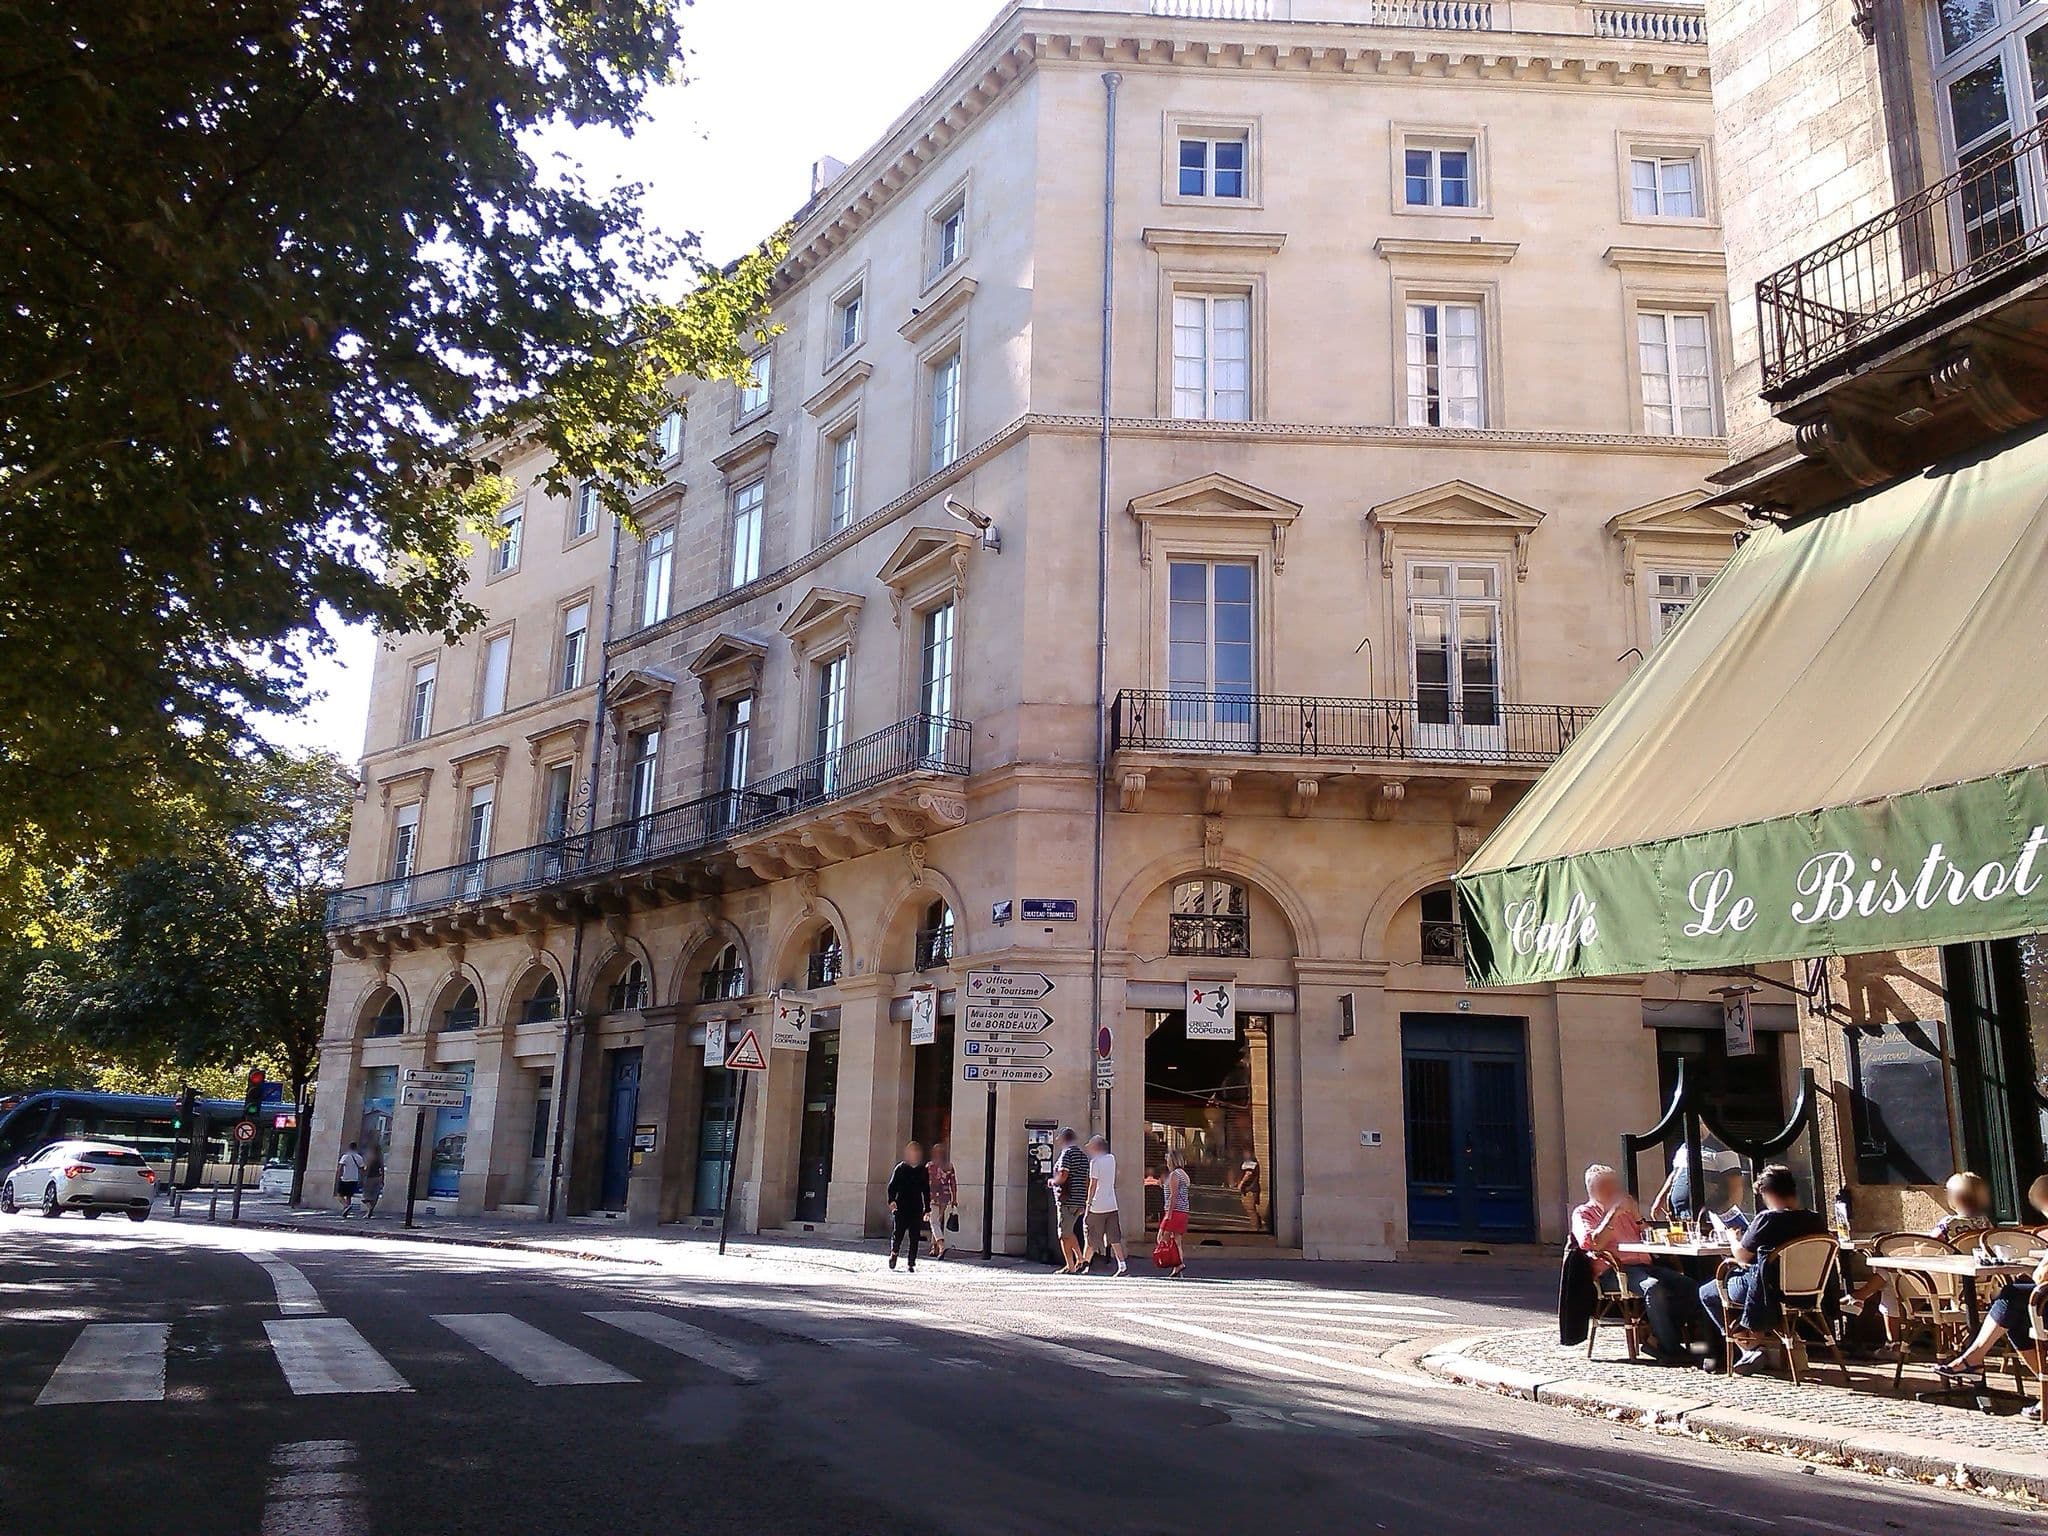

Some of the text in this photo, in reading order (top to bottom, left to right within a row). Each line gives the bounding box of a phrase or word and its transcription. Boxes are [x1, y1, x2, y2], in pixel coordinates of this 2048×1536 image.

[1503, 825, 2048, 974] Café Le Bistrot
[985, 976, 1013, 985] Office
[985, 986, 1040, 996] de Tourisme
[970, 1009, 1038, 1020] Maison du Vin
[970, 1020, 1038, 1030] de BORDEAUX
[1001, 1069, 1044, 1079] Hommes
